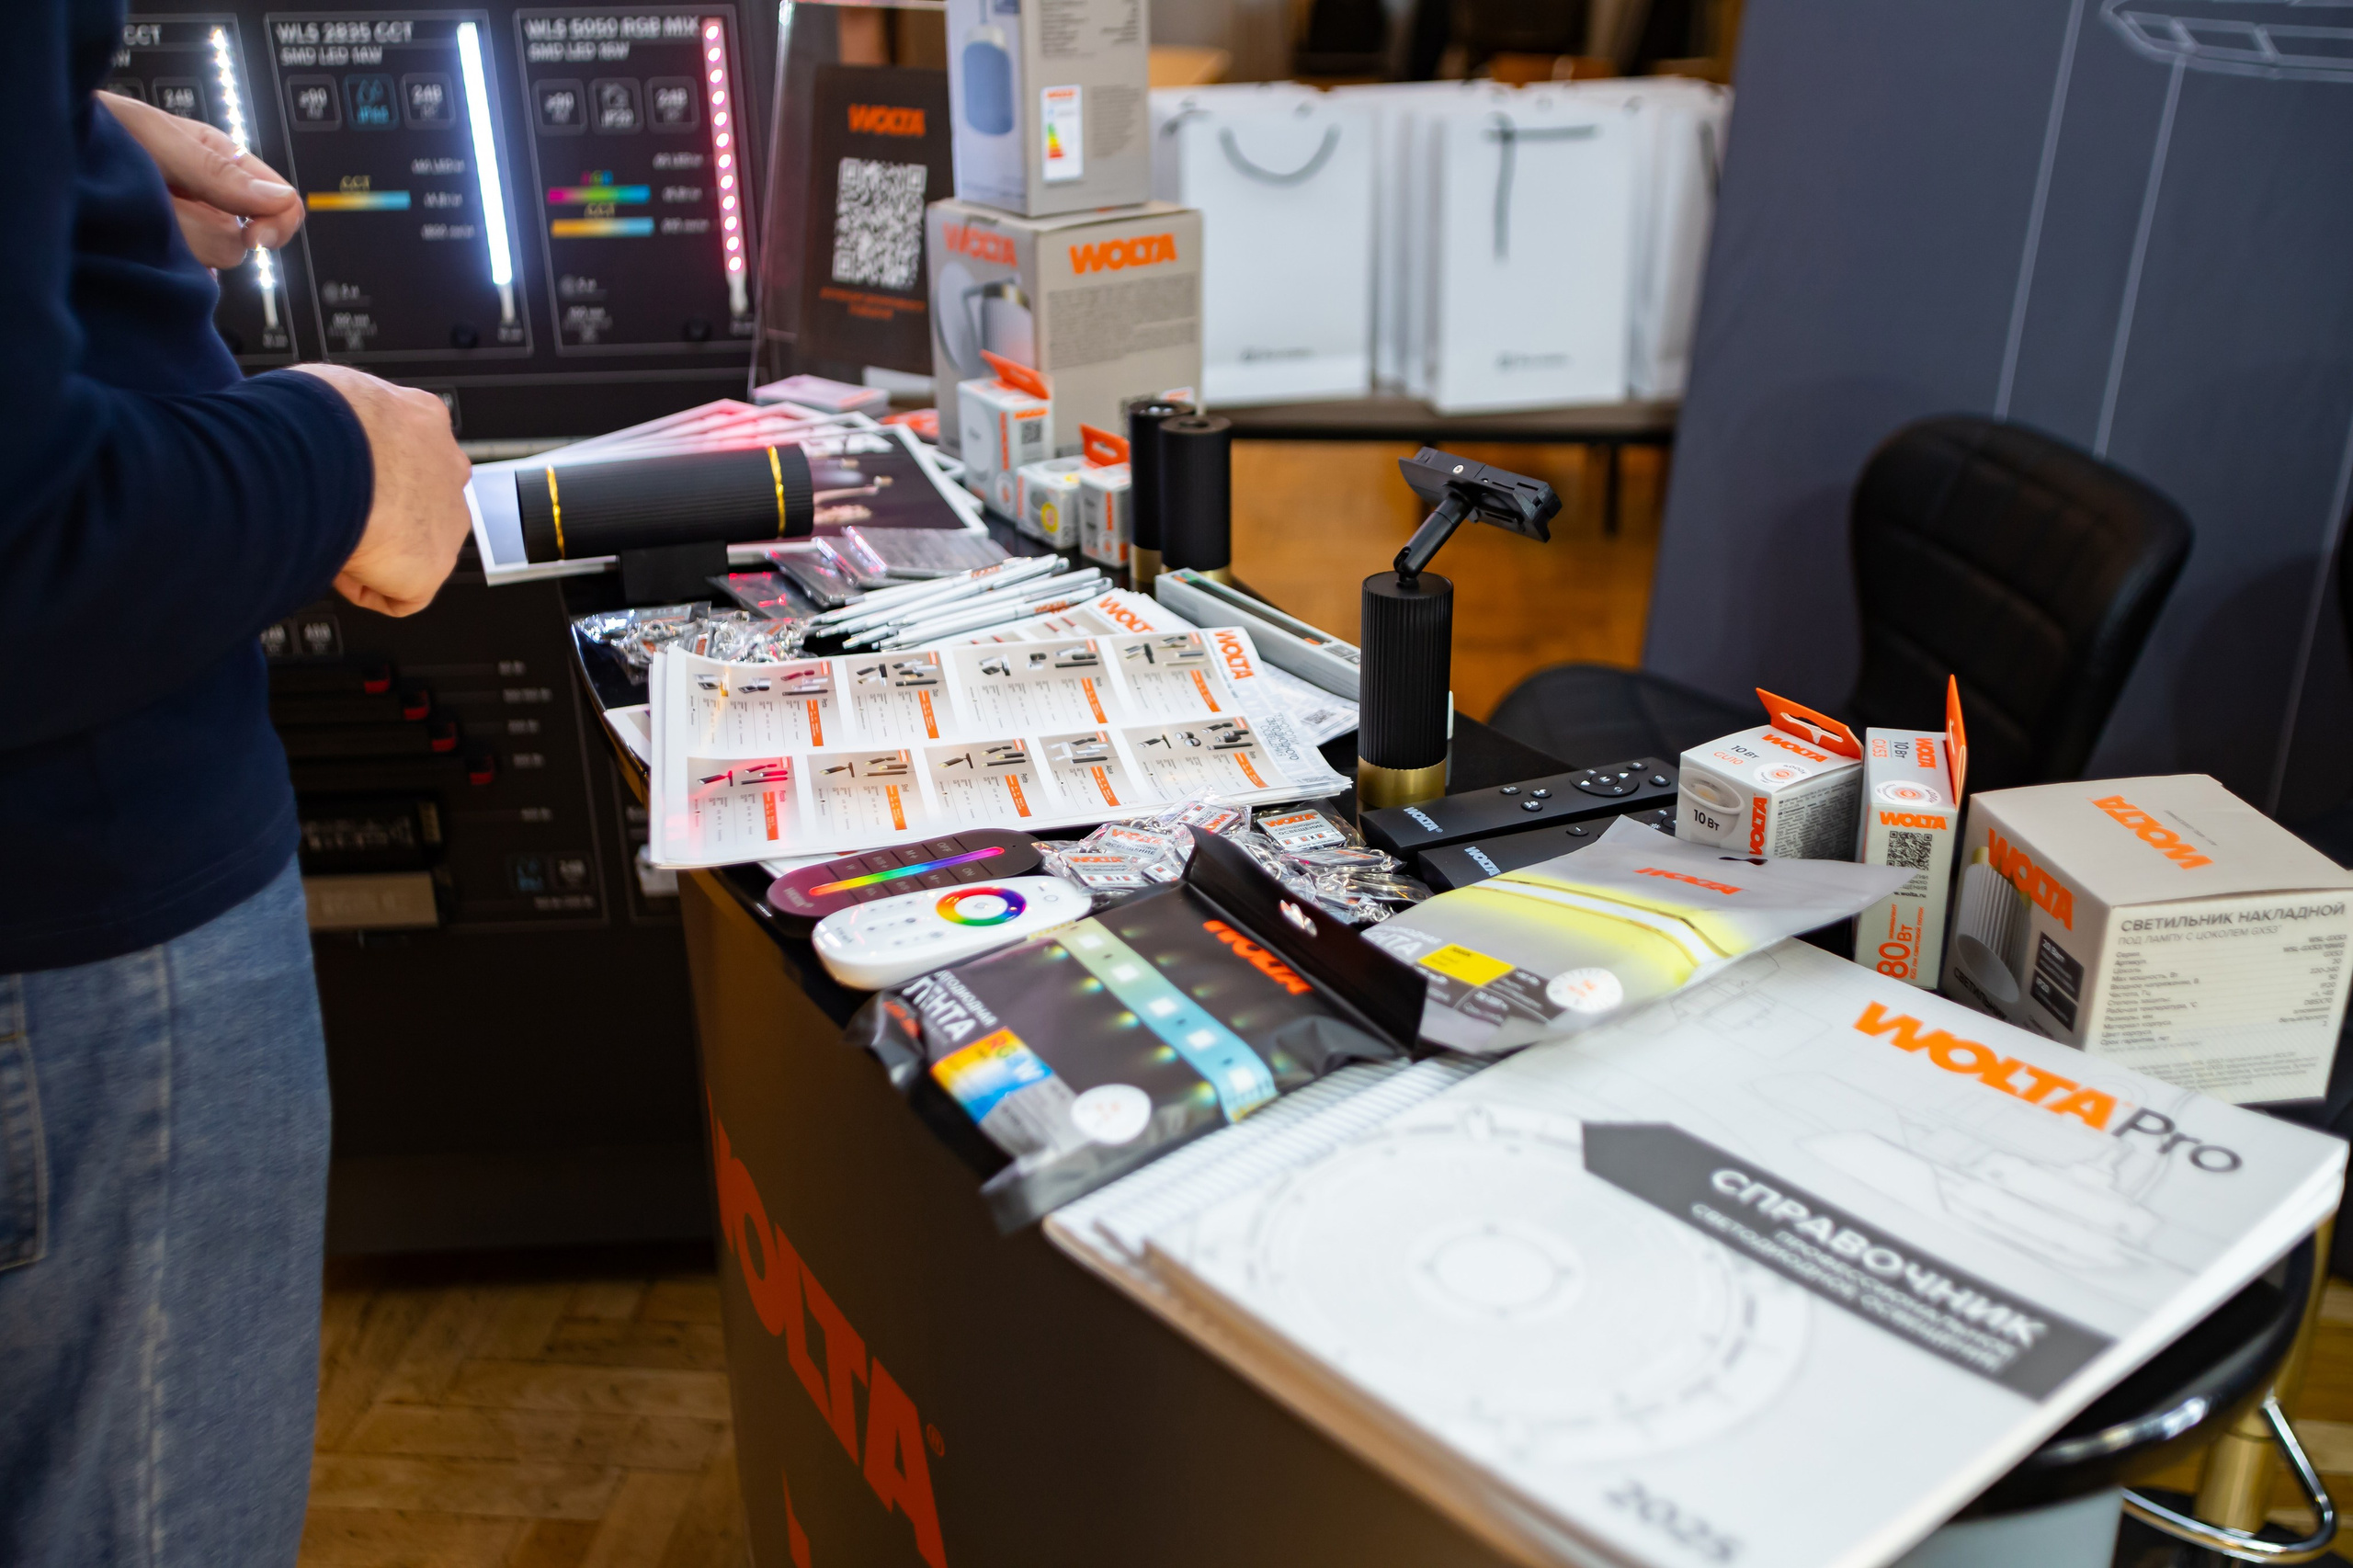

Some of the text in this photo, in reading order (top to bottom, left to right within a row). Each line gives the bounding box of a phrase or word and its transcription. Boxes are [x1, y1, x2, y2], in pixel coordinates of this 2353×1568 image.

[123, 24, 162, 45] CCT
[277, 22, 320, 44] WLS
[373, 21, 414, 43] CCT
[279, 46, 316, 66] SMD
[318, 46, 348, 66] LED
[943, 222, 1017, 267] WOLTA
[1069, 233, 1177, 275] WOLTA
[1098, 596, 1156, 633] WOLT
[1213, 630, 1255, 680] WOLTA
[1713, 751, 1745, 766] GU10
[1731, 744, 1746, 755] 10
[1761, 733, 1829, 763] WOLTA
[1871, 738, 1888, 757] GX53
[1894, 741, 1909, 750] 10
[1915, 737, 1937, 768] WOLTA
[1264, 812, 1317, 828] WOLTA
[1404, 806, 1439, 832] WOLTA
[1693, 809, 1707, 824] 10
[1880, 811, 1947, 830] WOLTA
[1111, 828, 1165, 845] WOLTA
[2091, 795, 2214, 870] WOLTA
[937, 842, 952, 853] OFF
[961, 868, 975, 878] ON
[1464, 846, 1501, 877] WOLTA
[1634, 867, 1745, 895] WOLTA
[1988, 827, 2074, 931] WOLTA
[1893, 891, 1927, 899] w.wolta.ru
[2120, 902, 2346, 932] СВЕТИЛЬНИК НАКЛАДНОЙ
[1366, 930, 1423, 957] НТА
[2118, 937, 2142, 946] ПОД
[2145, 933, 2182, 943] ЛАМПУ
[2186, 932, 2192, 940] С
[2196, 928, 2249, 941] ЦОКОЛЕМ
[1202, 919, 1313, 995] WOLTA
[1876, 924, 1913, 979] 80 Вт
[933, 970, 999, 1028] ЕТОДИОДНАЯ
[1852, 1000, 2244, 1174] WOLTA Pro
[1711, 1168, 2049, 1348] СПРАВОЧНИК
